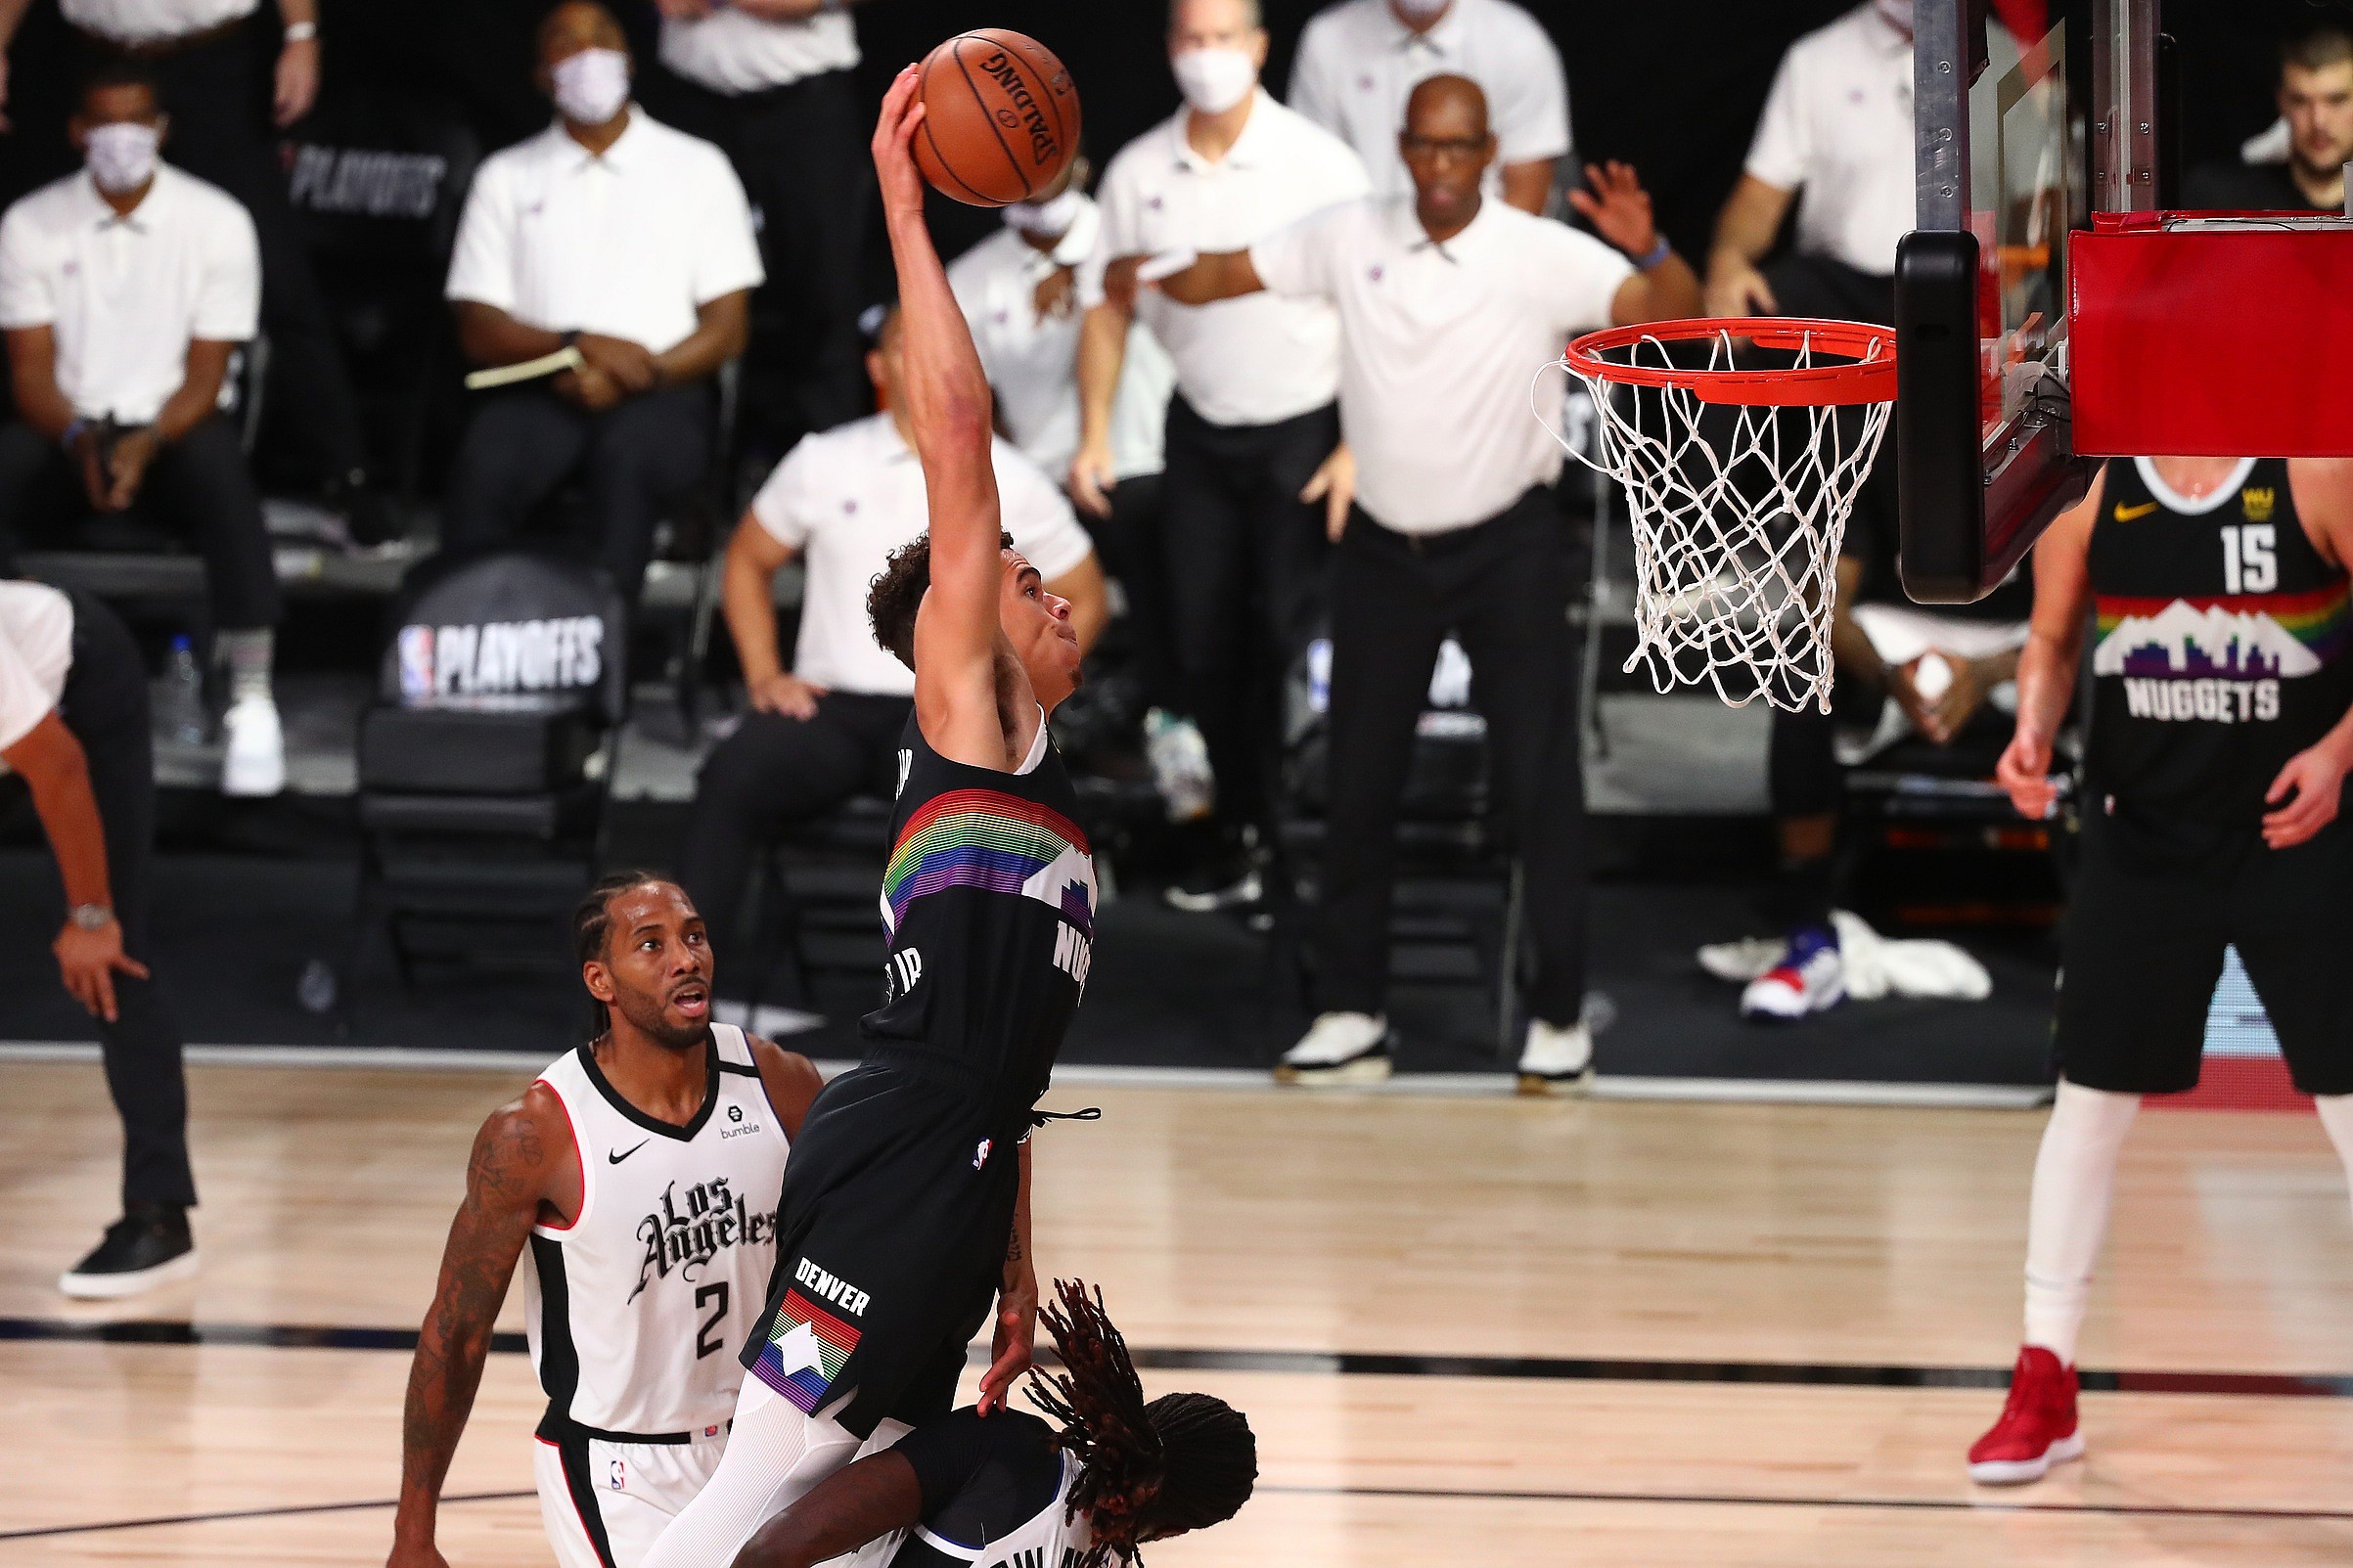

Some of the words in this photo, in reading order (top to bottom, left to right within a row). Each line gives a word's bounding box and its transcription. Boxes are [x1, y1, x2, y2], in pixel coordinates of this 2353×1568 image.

[979, 52, 1058, 166] SPALDING
[2220, 523, 2279, 595] 15
[436, 615, 604, 692] PLAYOFFS
[2123, 677, 2281, 725] NUGGETS
[720, 1123, 760, 1140] bumble
[658, 1177, 734, 1232] Los
[626, 1192, 777, 1306] Angeles
[695, 1281, 729, 1360] 2
[794, 1256, 871, 1318] DENVER
